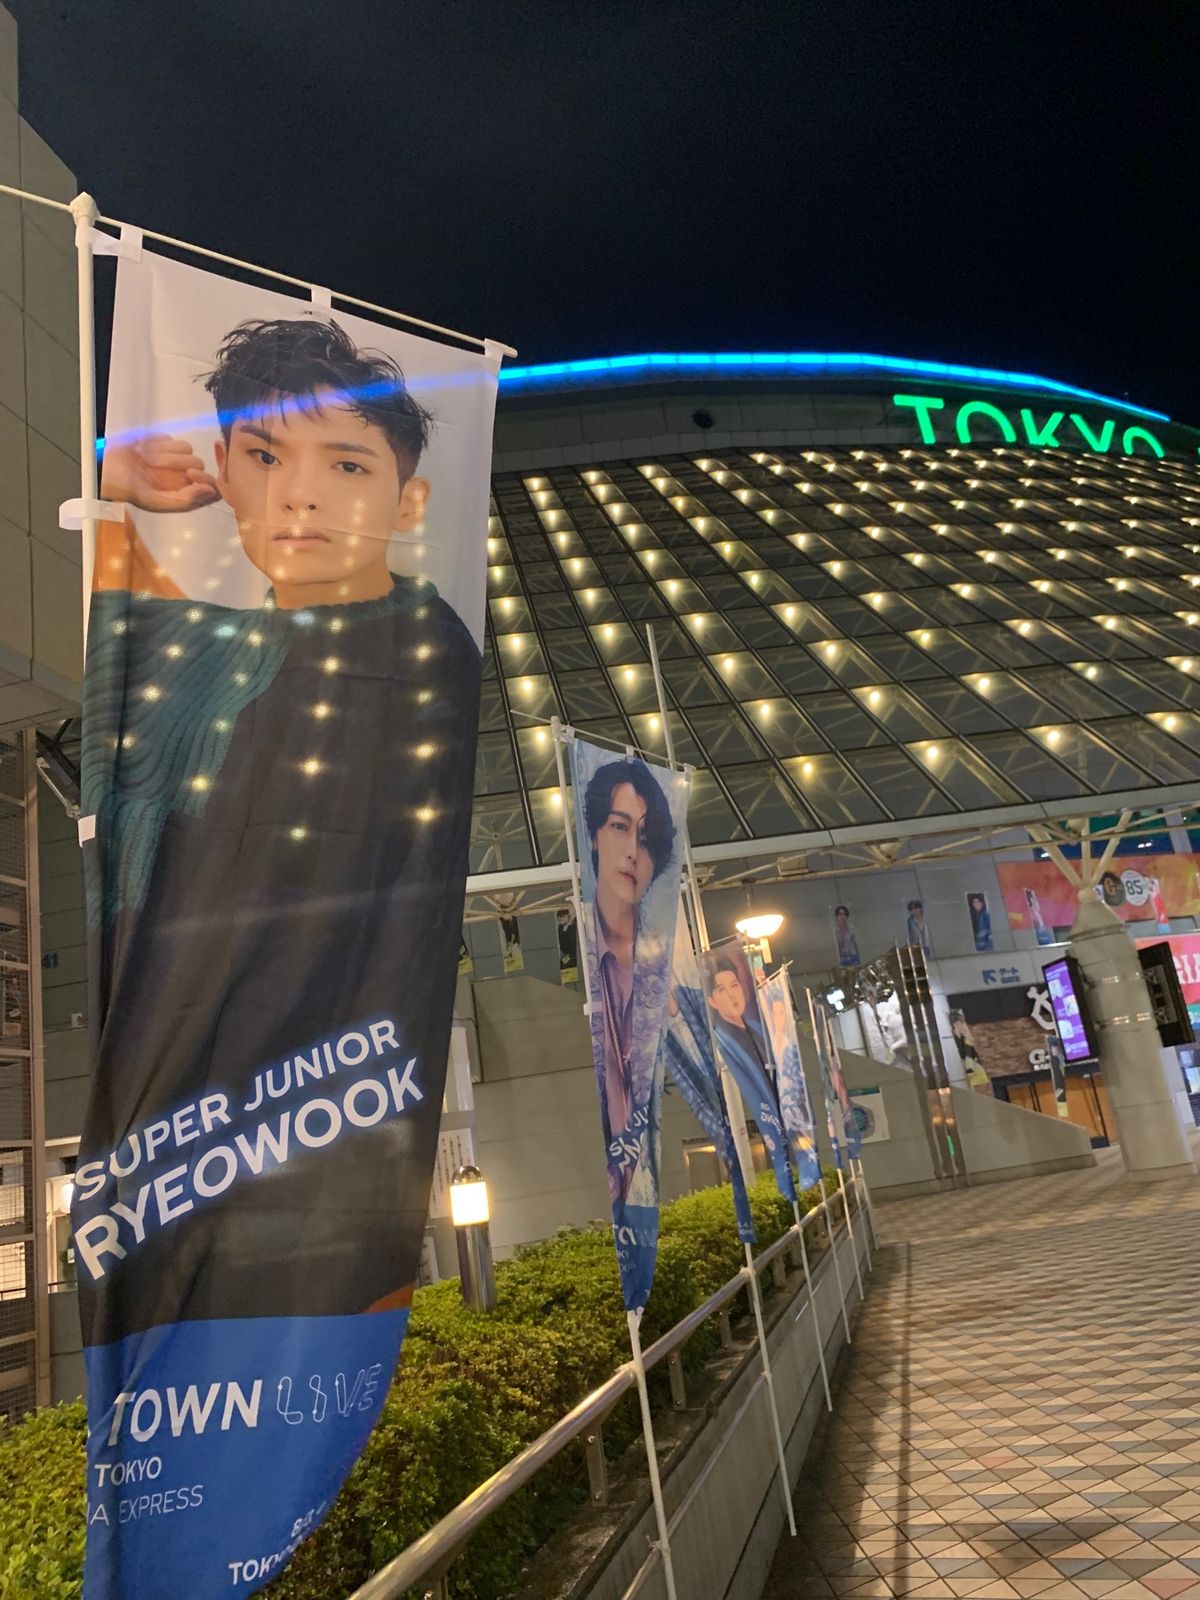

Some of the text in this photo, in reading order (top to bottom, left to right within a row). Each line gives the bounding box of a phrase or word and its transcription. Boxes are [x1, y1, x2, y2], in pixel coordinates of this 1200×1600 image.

[1125, 880, 1143, 895] 85
[75, 1019, 400, 1200] SUPER JUNIOR
[74, 1057, 424, 1281] RYEOWOOK
[107, 1379, 263, 1446] TOWN
[94, 1456, 162, 1487] TOKYO
[119, 1485, 204, 1523] EXPRESS
